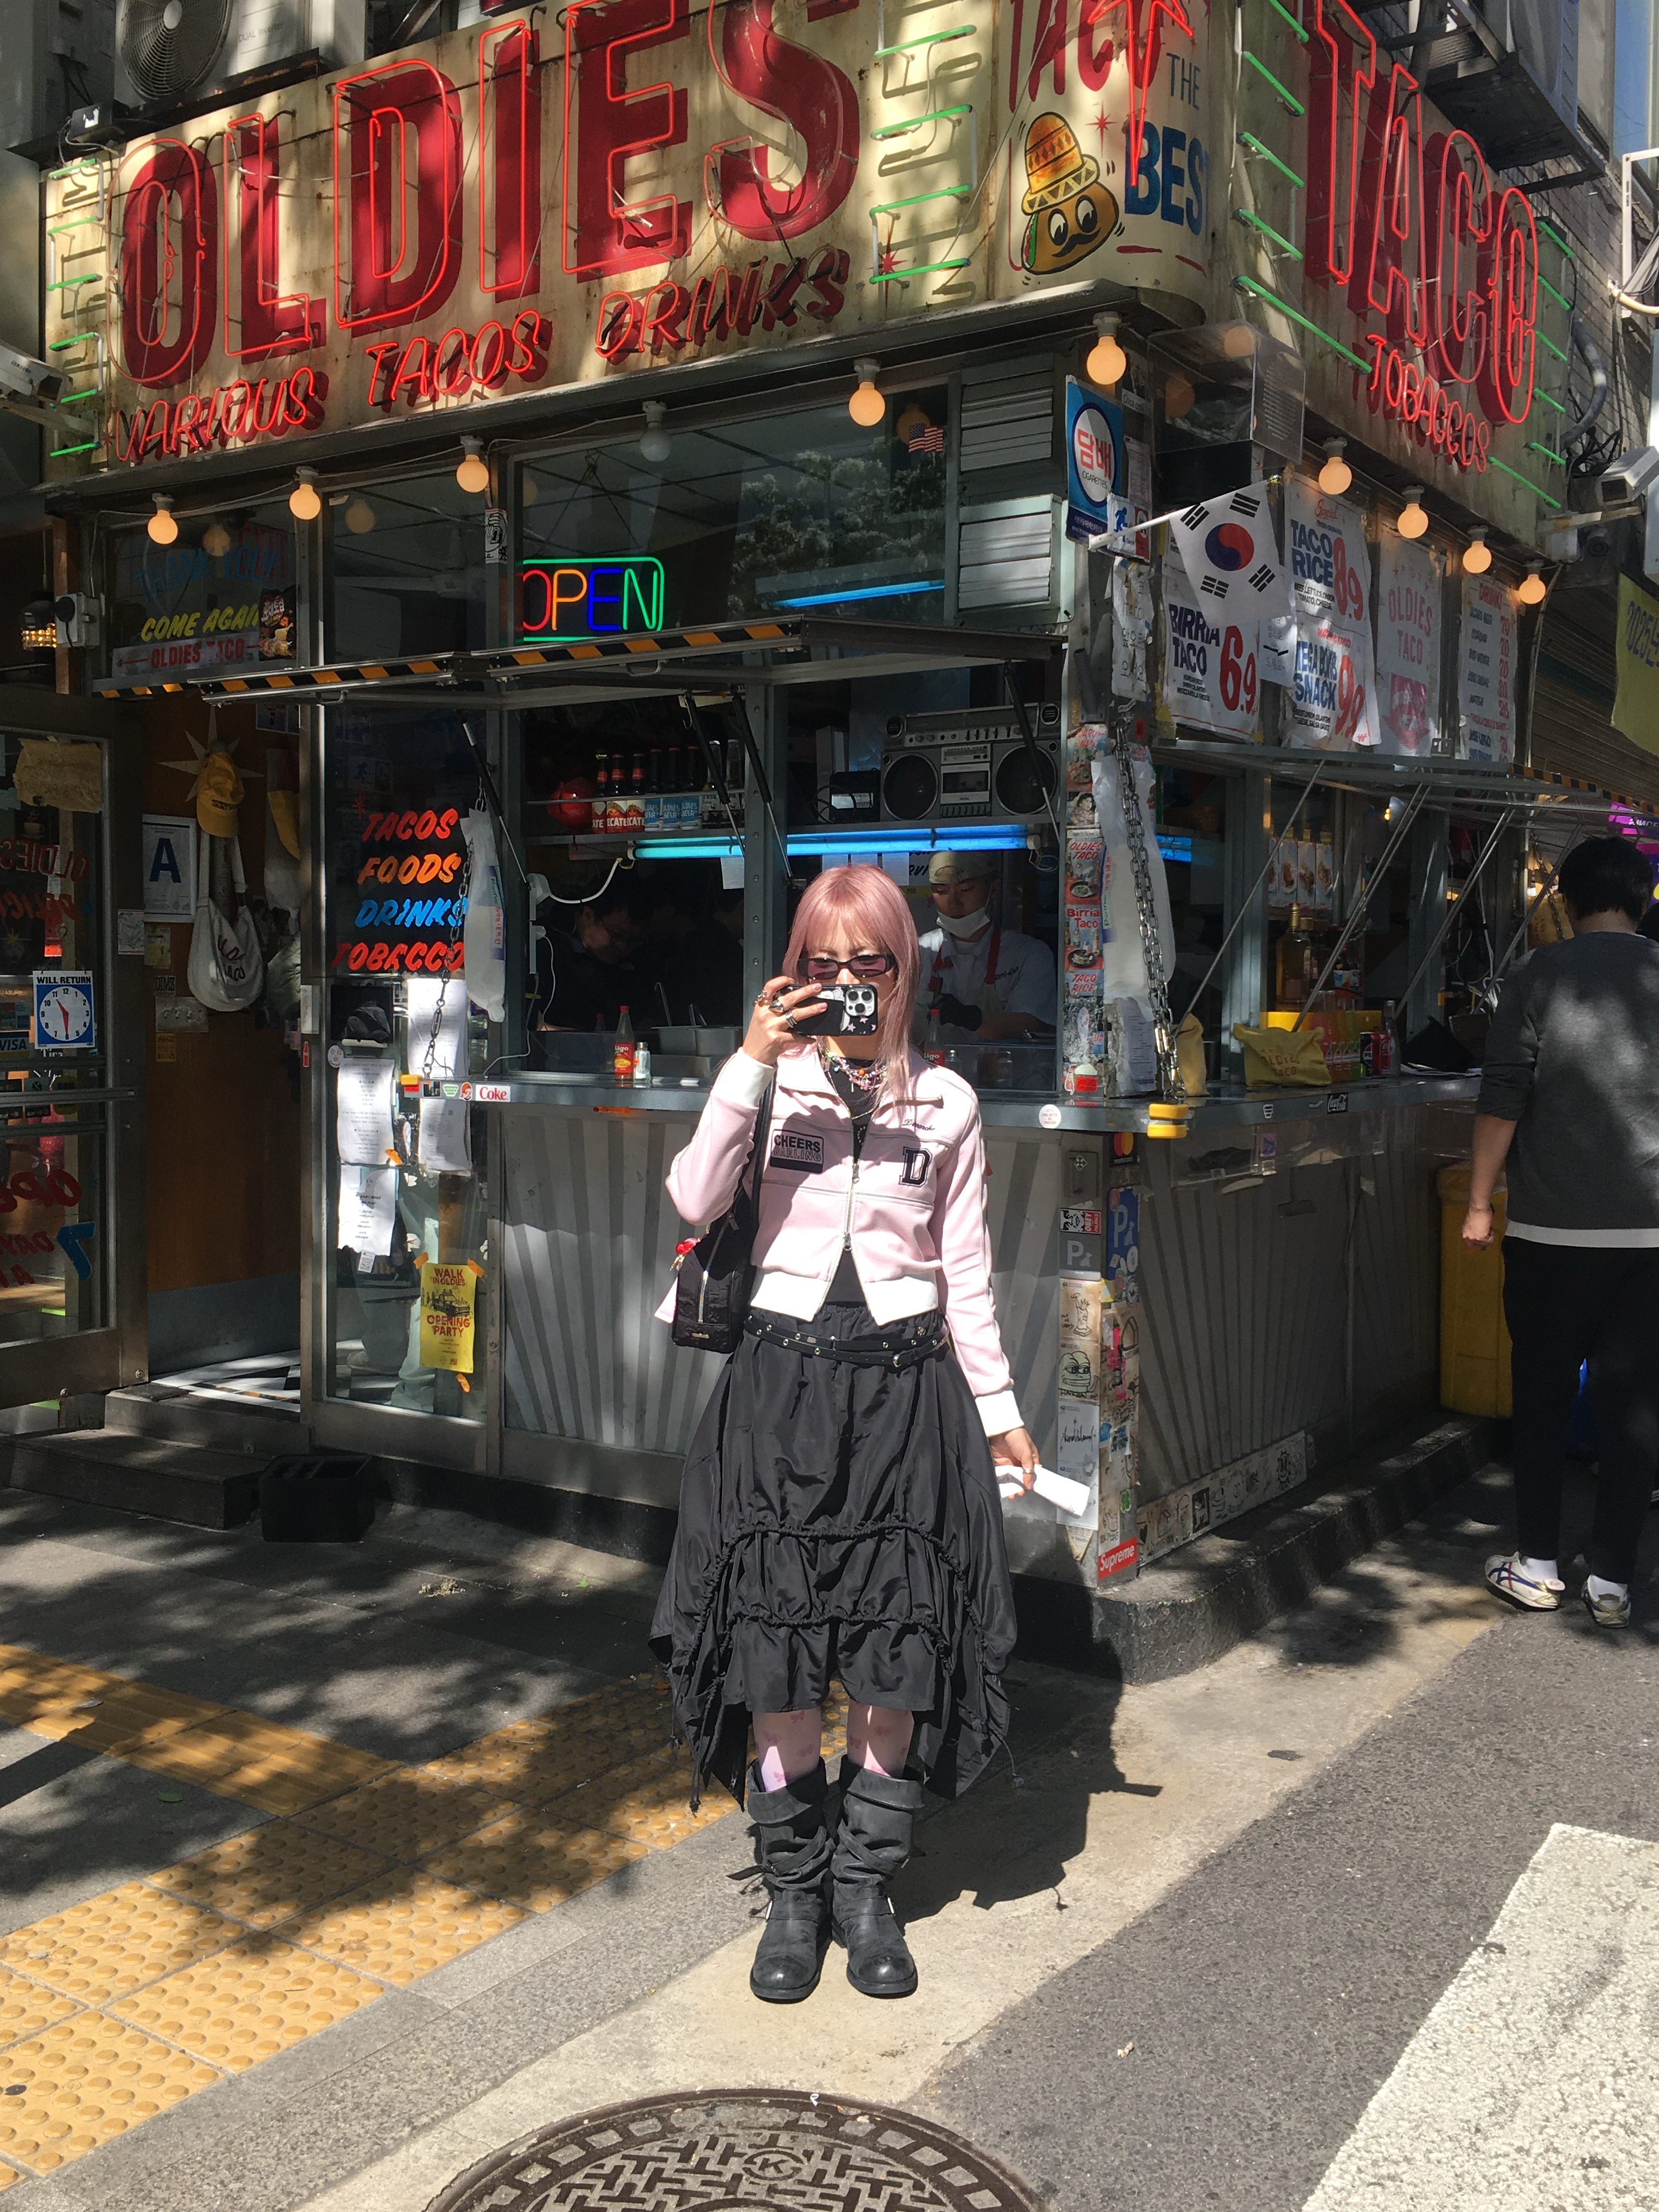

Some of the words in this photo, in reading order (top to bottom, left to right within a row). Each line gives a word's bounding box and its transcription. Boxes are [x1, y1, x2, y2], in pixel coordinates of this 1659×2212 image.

[239, 32, 256, 42] DUAL
[1166, 52, 1201, 111] THE
[108, 0, 860, 389] OLDIES
[1306, 0, 1539, 426] TACO
[596, 248, 851, 365] DRINKS
[365, 309, 553, 408] TACOS
[116, 366, 329, 465] VARIOUS
[1077, 428, 1112, 479] 담배
[1082, 470, 1108, 489] CIGARETTES
[1290, 518, 1333, 560] TACO
[132, 547, 214, 604] THANK
[1291, 547, 1334, 588] RICE
[1333, 536, 1364, 621] 8.9
[521, 567, 659, 632] OPEN
[1388, 586, 1434, 638] OLDIES
[140, 612, 200, 642] COME
[1168, 603, 1221, 647] BIRRIA
[151, 642, 202, 669] OLDIES
[1172, 636, 1208, 677] TACO
[1397, 629, 1424, 665] TACO
[1219, 625, 1256, 715] 6.9
[1293, 671, 1337, 711] SNACK
[362, 808, 459, 842] TACOS
[606, 817, 628, 827] ECATE
[149, 838, 182, 883] A
[1069, 842, 1104, 851] OLDIES
[1073, 851, 1099, 860] TACO
[357, 853, 463, 885] FOODS
[355, 897, 468, 928] DRINKS
[1066, 908, 1101, 918] Birria
[1074, 918, 1099, 928] Taco
[331, 940, 465, 972] TOBACCO
[1071, 983, 1095, 993] RICE
[1072, 973, 1098, 983] TACO
[0, 1038, 27, 1051] VISA
[924, 1052, 940, 1061] Ligo
[1278, 1066, 1297, 1077] ACO
[479, 1086, 508, 1101] Coke
[774, 1134, 821, 1153] CHEERS
[774, 1145, 822, 1163] DARLING
[899, 1146, 933, 1187] D
[1067, 1240, 1084, 1265] P
[434, 1267, 464, 1280] WALK
[440, 1278, 466, 1287] OLDIES
[427, 1314, 470, 1328] OPENING
[433, 1326, 465, 1338] PARTY
[1100, 1545, 1135, 1572] Supreme
